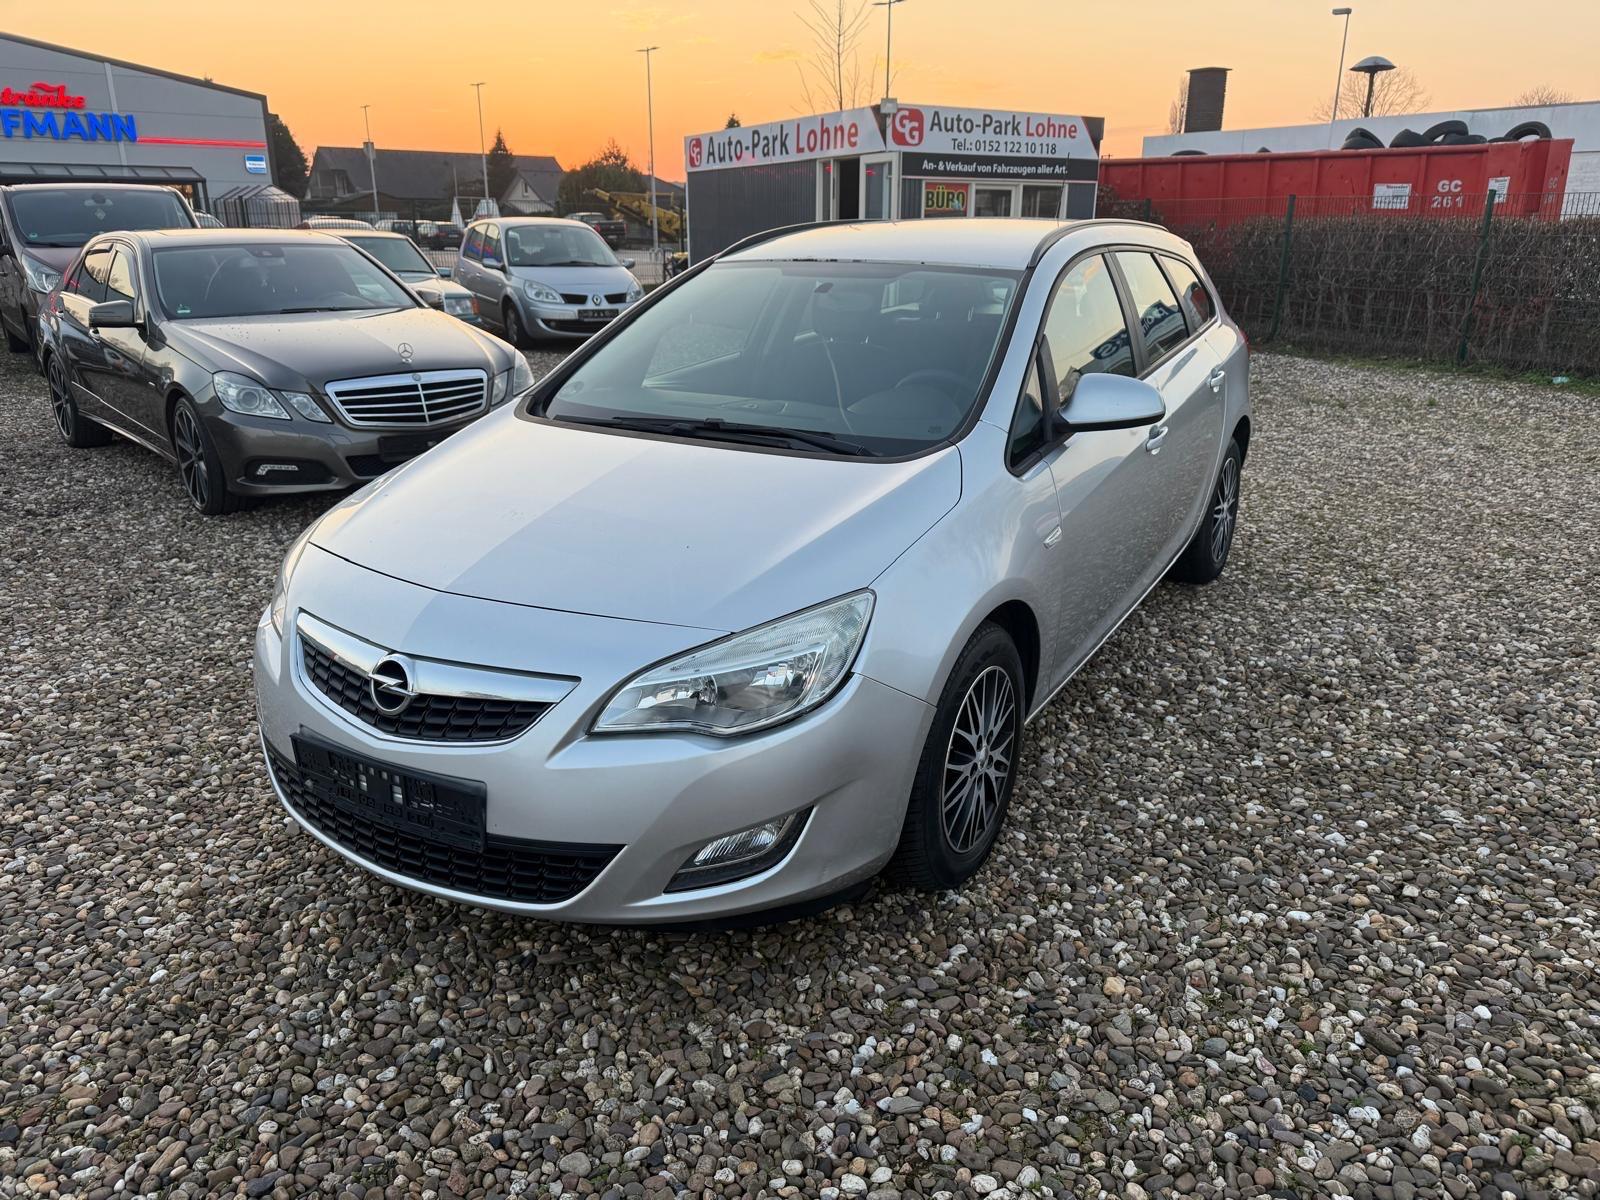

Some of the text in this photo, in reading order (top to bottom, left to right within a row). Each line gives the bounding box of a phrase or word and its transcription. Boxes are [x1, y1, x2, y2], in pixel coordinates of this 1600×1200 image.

[0, 107, 137, 142] FMANN
[929, 111, 1078, 139] Auto-Park Lohne
[706, 117, 859, 164] Auto-Park Lohne
[951, 138, 1057, 155] Tel.: 0152 122 10 118
[922, 160, 1069, 176] An- & Verkauf von Fahrzeugen aller Art.
[925, 184, 966, 210] BÜRO
[1438, 180, 1463, 193] GC
